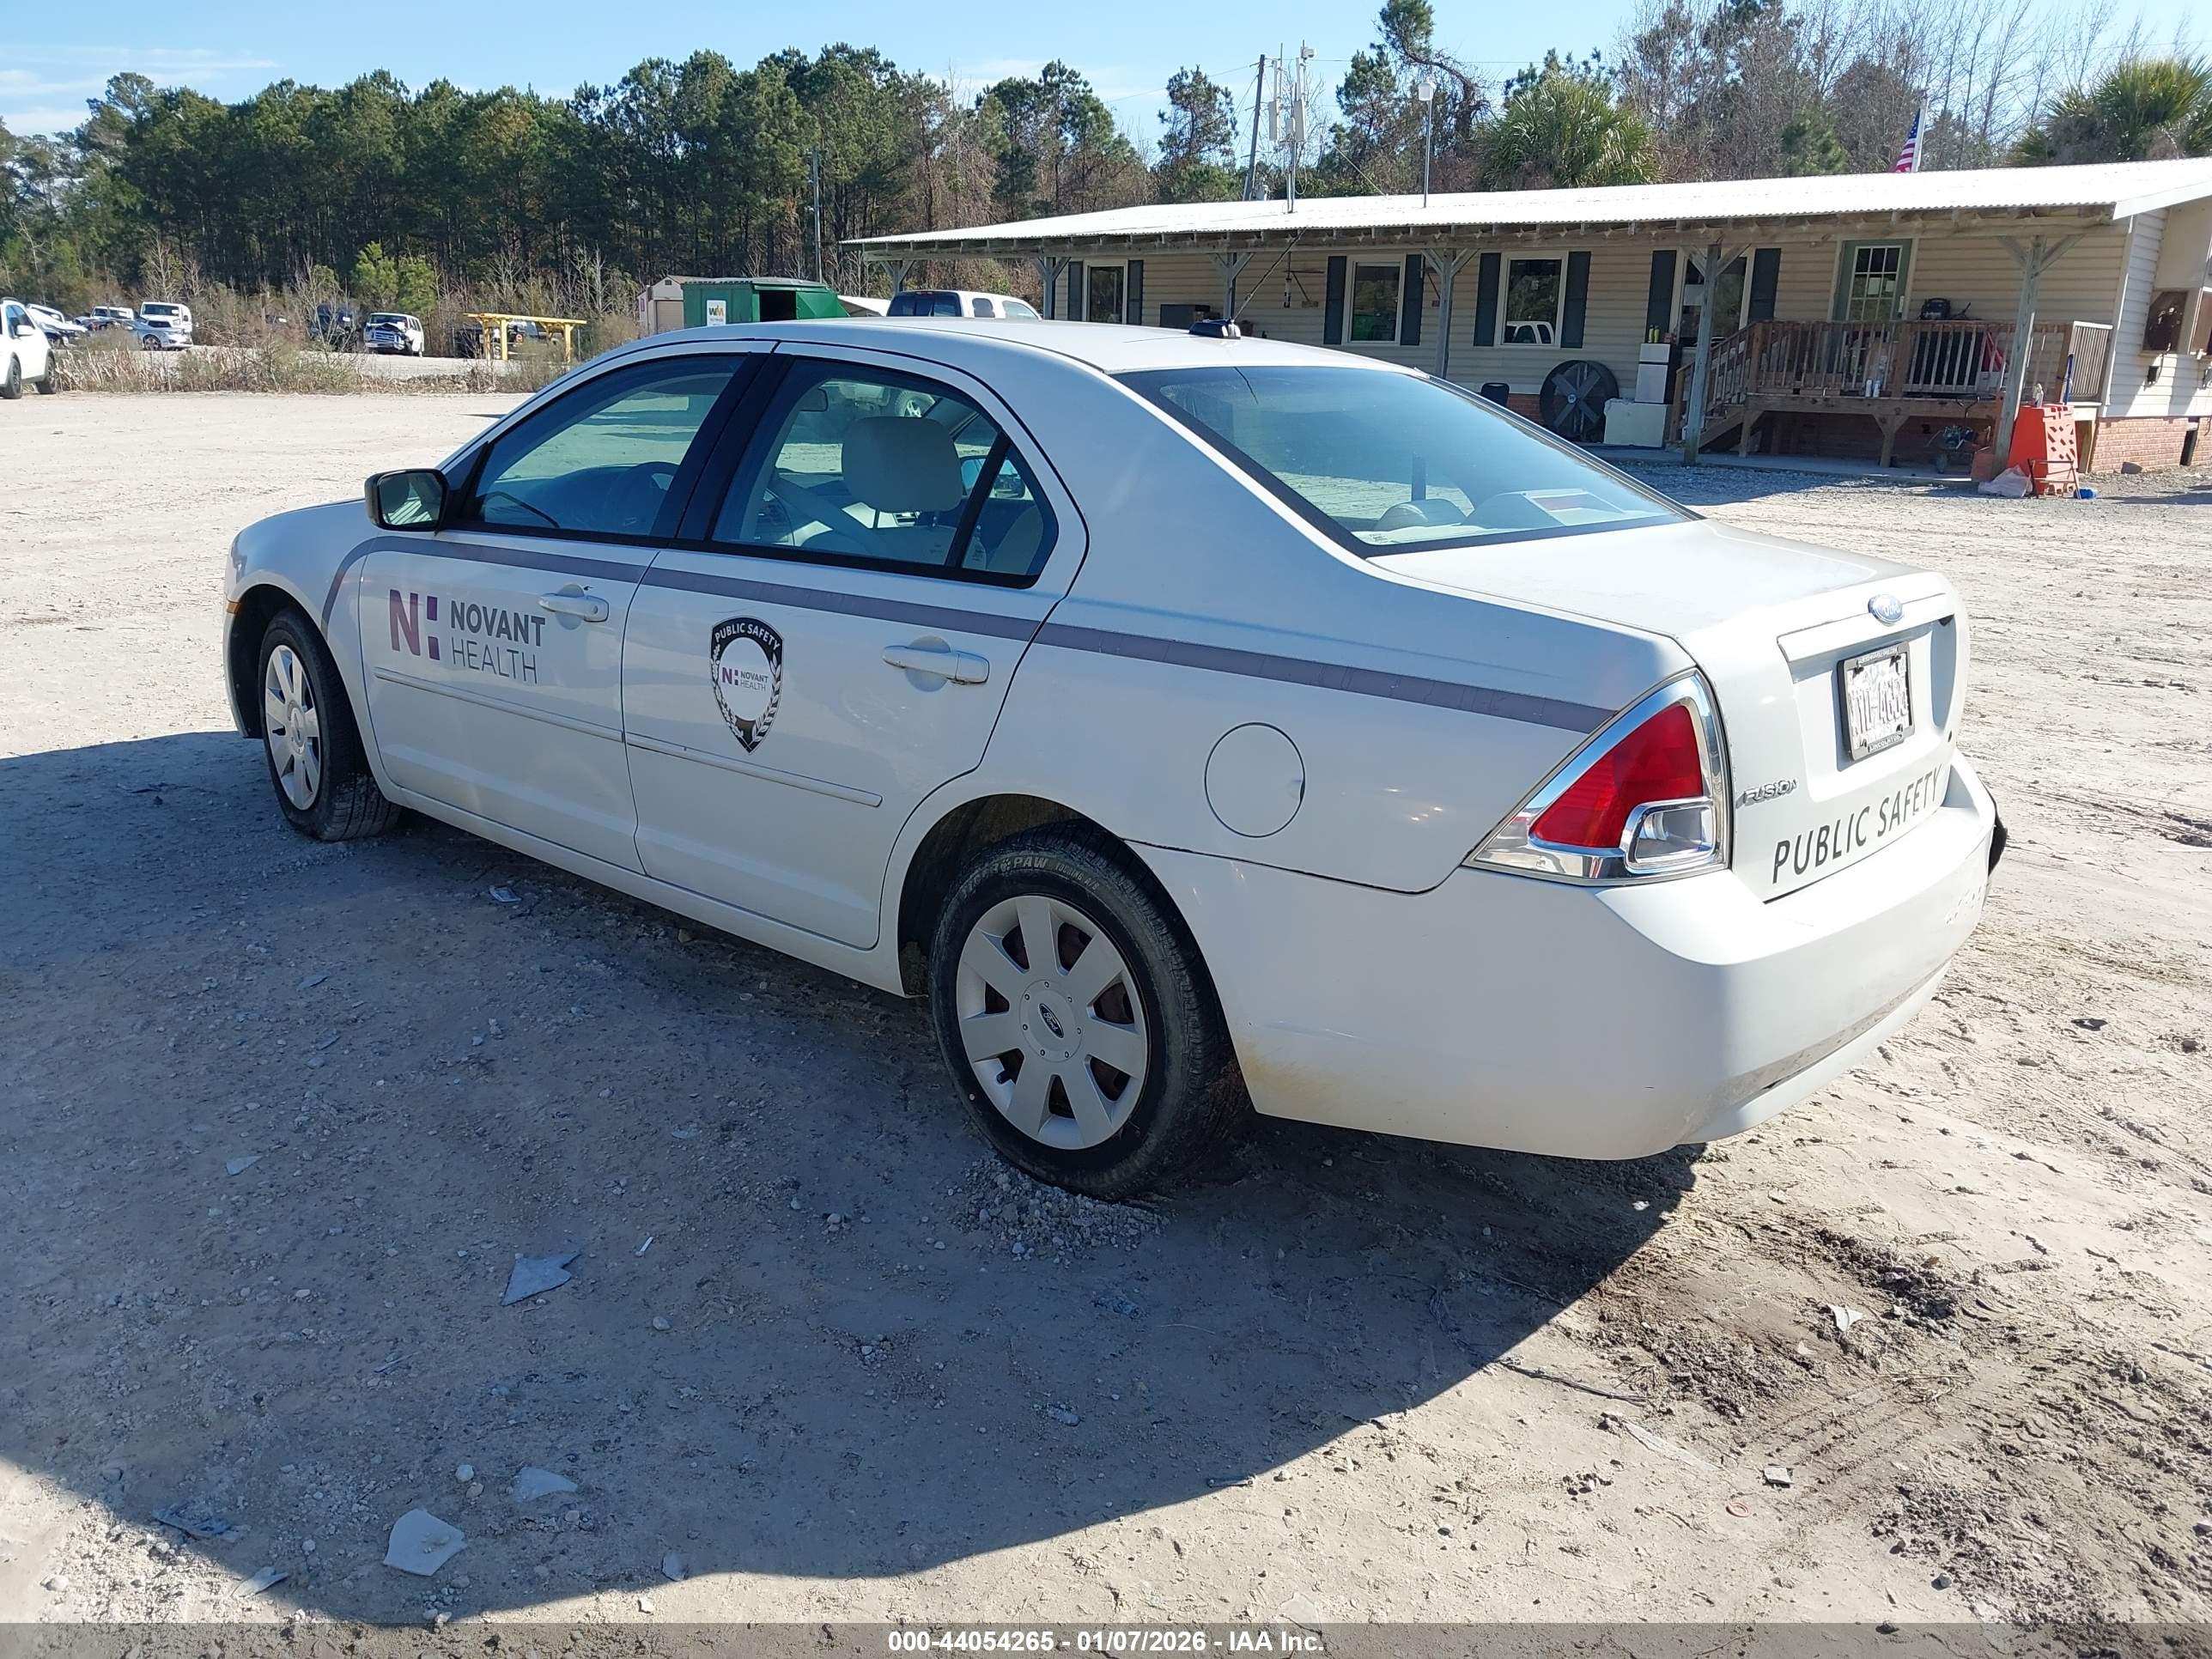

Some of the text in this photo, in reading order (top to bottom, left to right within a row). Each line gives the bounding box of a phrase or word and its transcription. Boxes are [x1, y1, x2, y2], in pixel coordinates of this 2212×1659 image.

[450, 600, 546, 647] NOVANT
[714, 623, 781, 651] PUBLIC SAFETY
[451, 636, 538, 684] HEALTH
[739, 680, 766, 691] HEALTH
[740, 671, 769, 684] NOVANT
[1771, 763, 1942, 884] PUBLIC SAFETY
[1013, 857, 1048, 868] PAW
